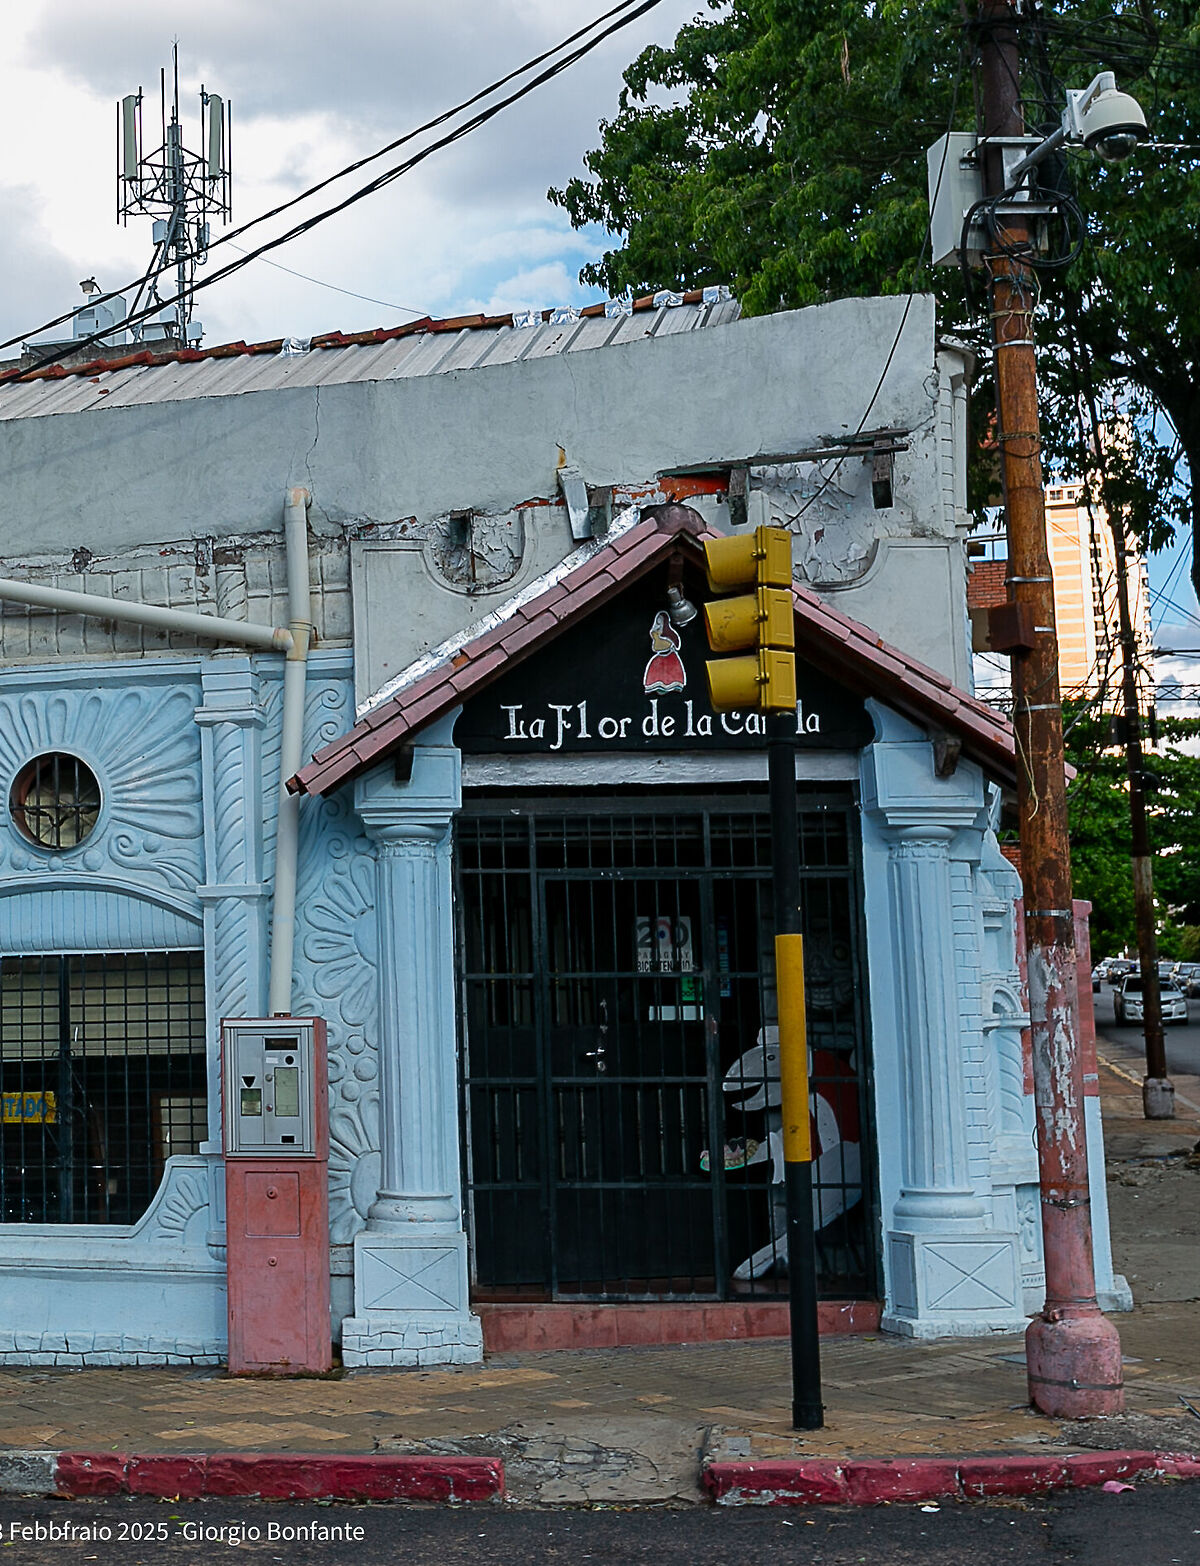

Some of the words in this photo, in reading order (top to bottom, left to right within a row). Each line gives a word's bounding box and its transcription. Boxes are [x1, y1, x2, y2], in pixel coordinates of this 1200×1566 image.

[500, 704, 545, 739] La
[548, 700, 632, 750] Flor
[642, 699, 675, 736] de
[683, 699, 712, 736] la
[721, 699, 821, 736] Cala
